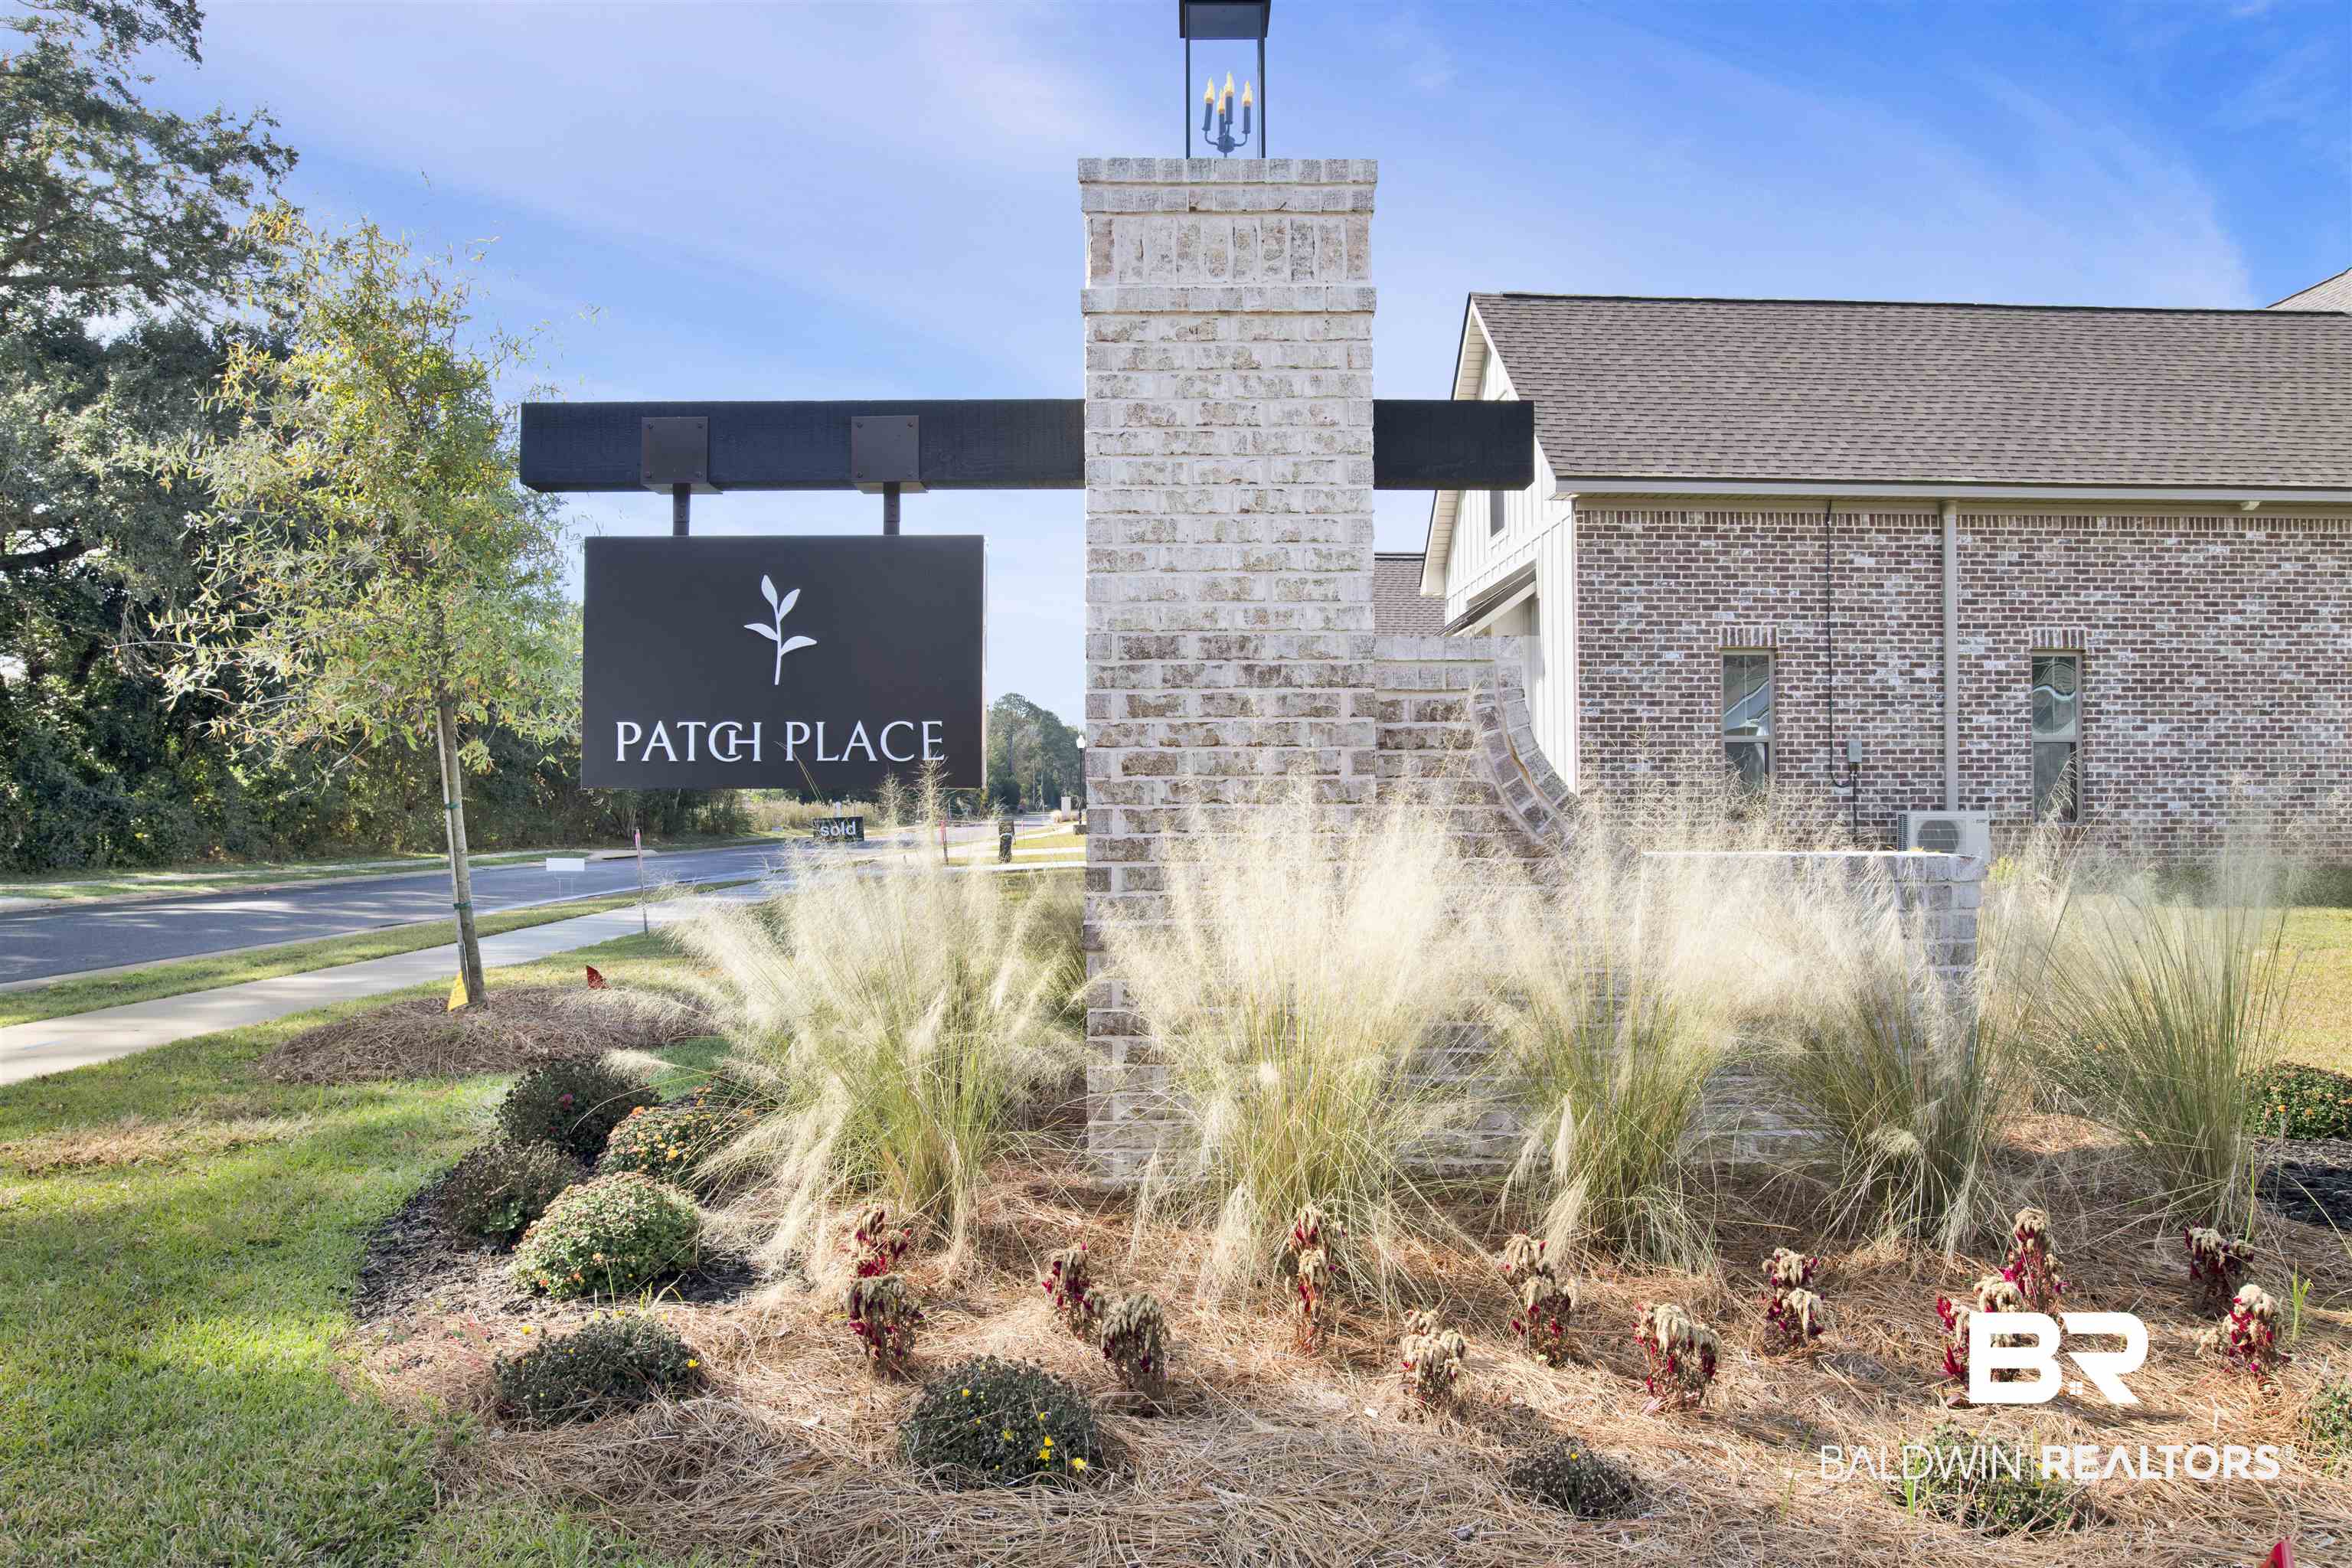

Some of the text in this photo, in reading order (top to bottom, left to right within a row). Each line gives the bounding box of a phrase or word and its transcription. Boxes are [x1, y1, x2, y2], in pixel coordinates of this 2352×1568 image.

[616, 720, 946, 763] PATCH PLACE
[820, 820, 856, 837] sold
